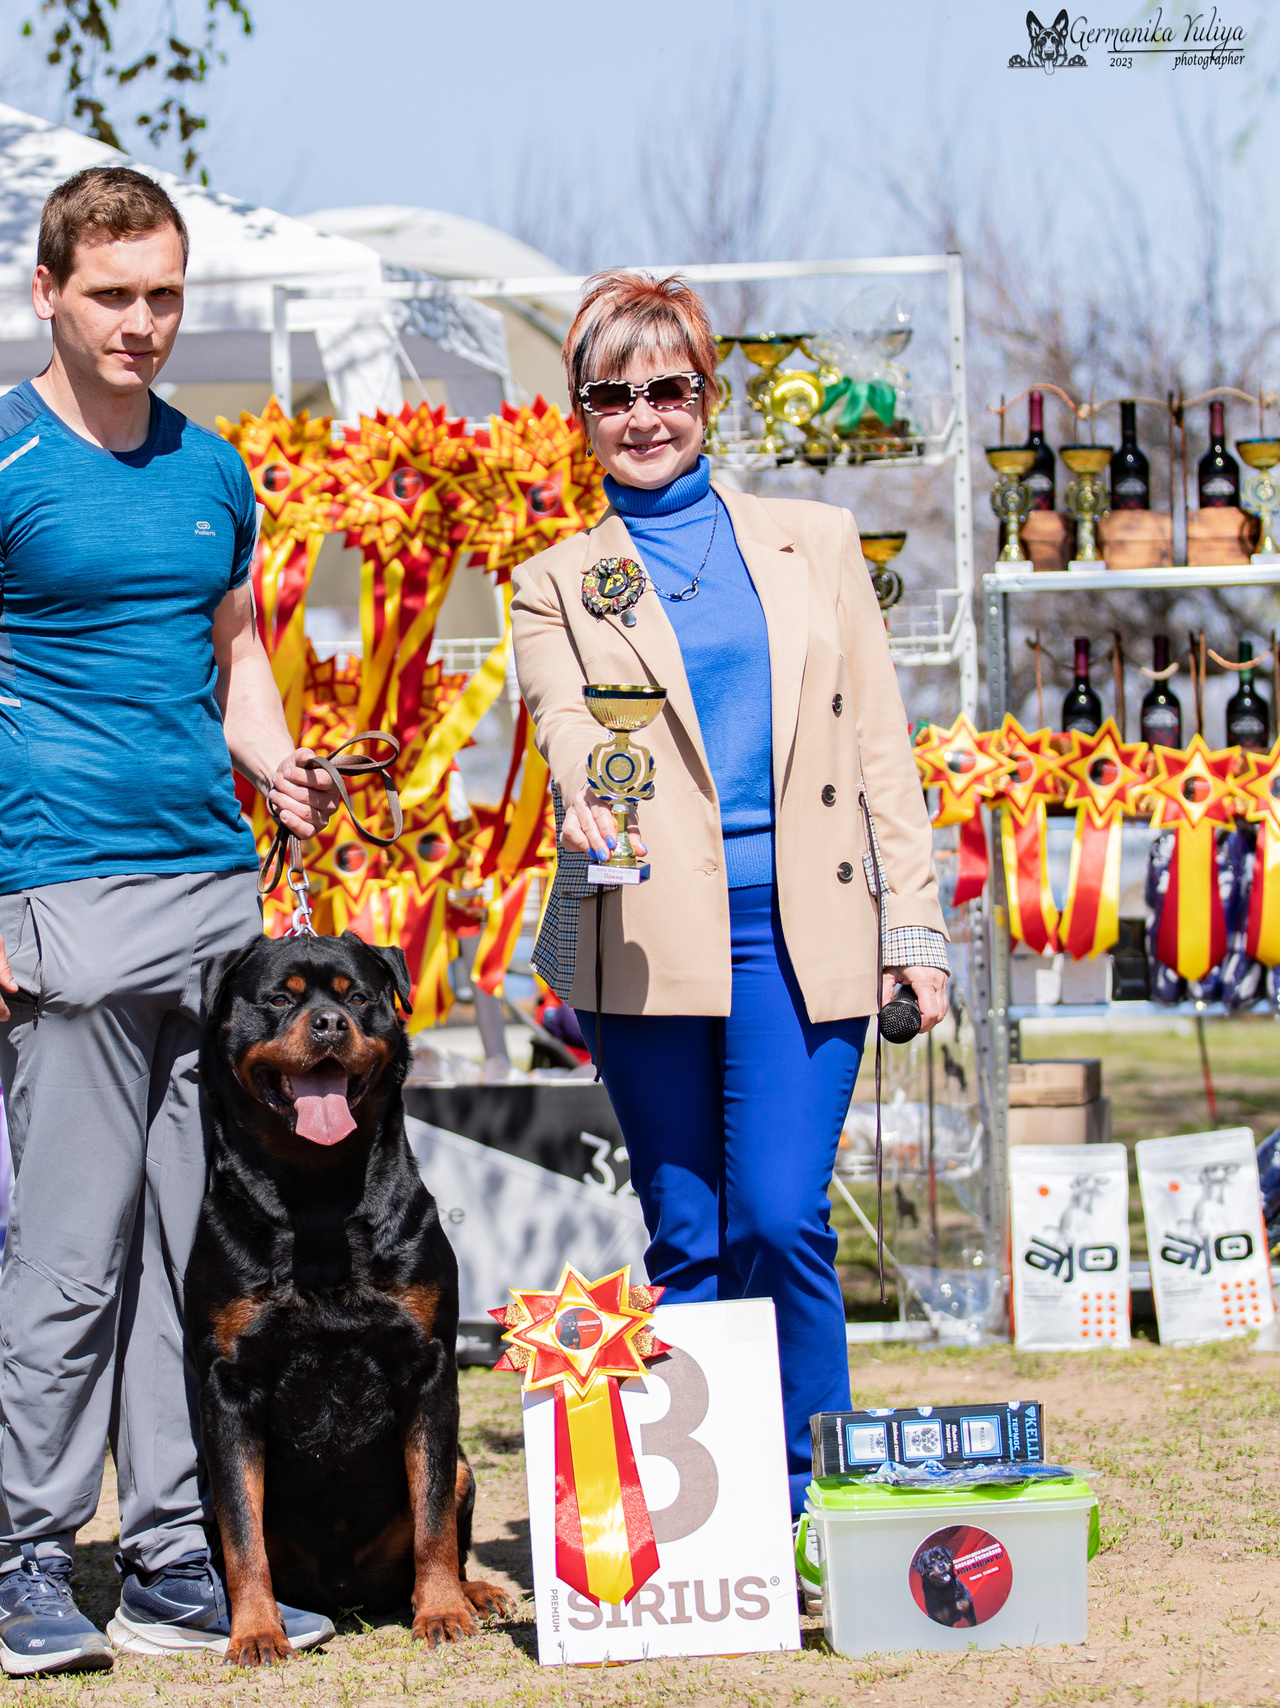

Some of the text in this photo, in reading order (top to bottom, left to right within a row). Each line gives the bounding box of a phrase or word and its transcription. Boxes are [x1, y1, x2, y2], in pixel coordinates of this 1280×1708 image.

[623, 1343, 719, 1545] 3
[1011, 1417, 1020, 1451] ТЕРМОС
[1024, 1417, 1040, 1460] KELLI
[550, 1588, 561, 1633] PREMIUM
[567, 1576, 770, 1630] SIRIUS
